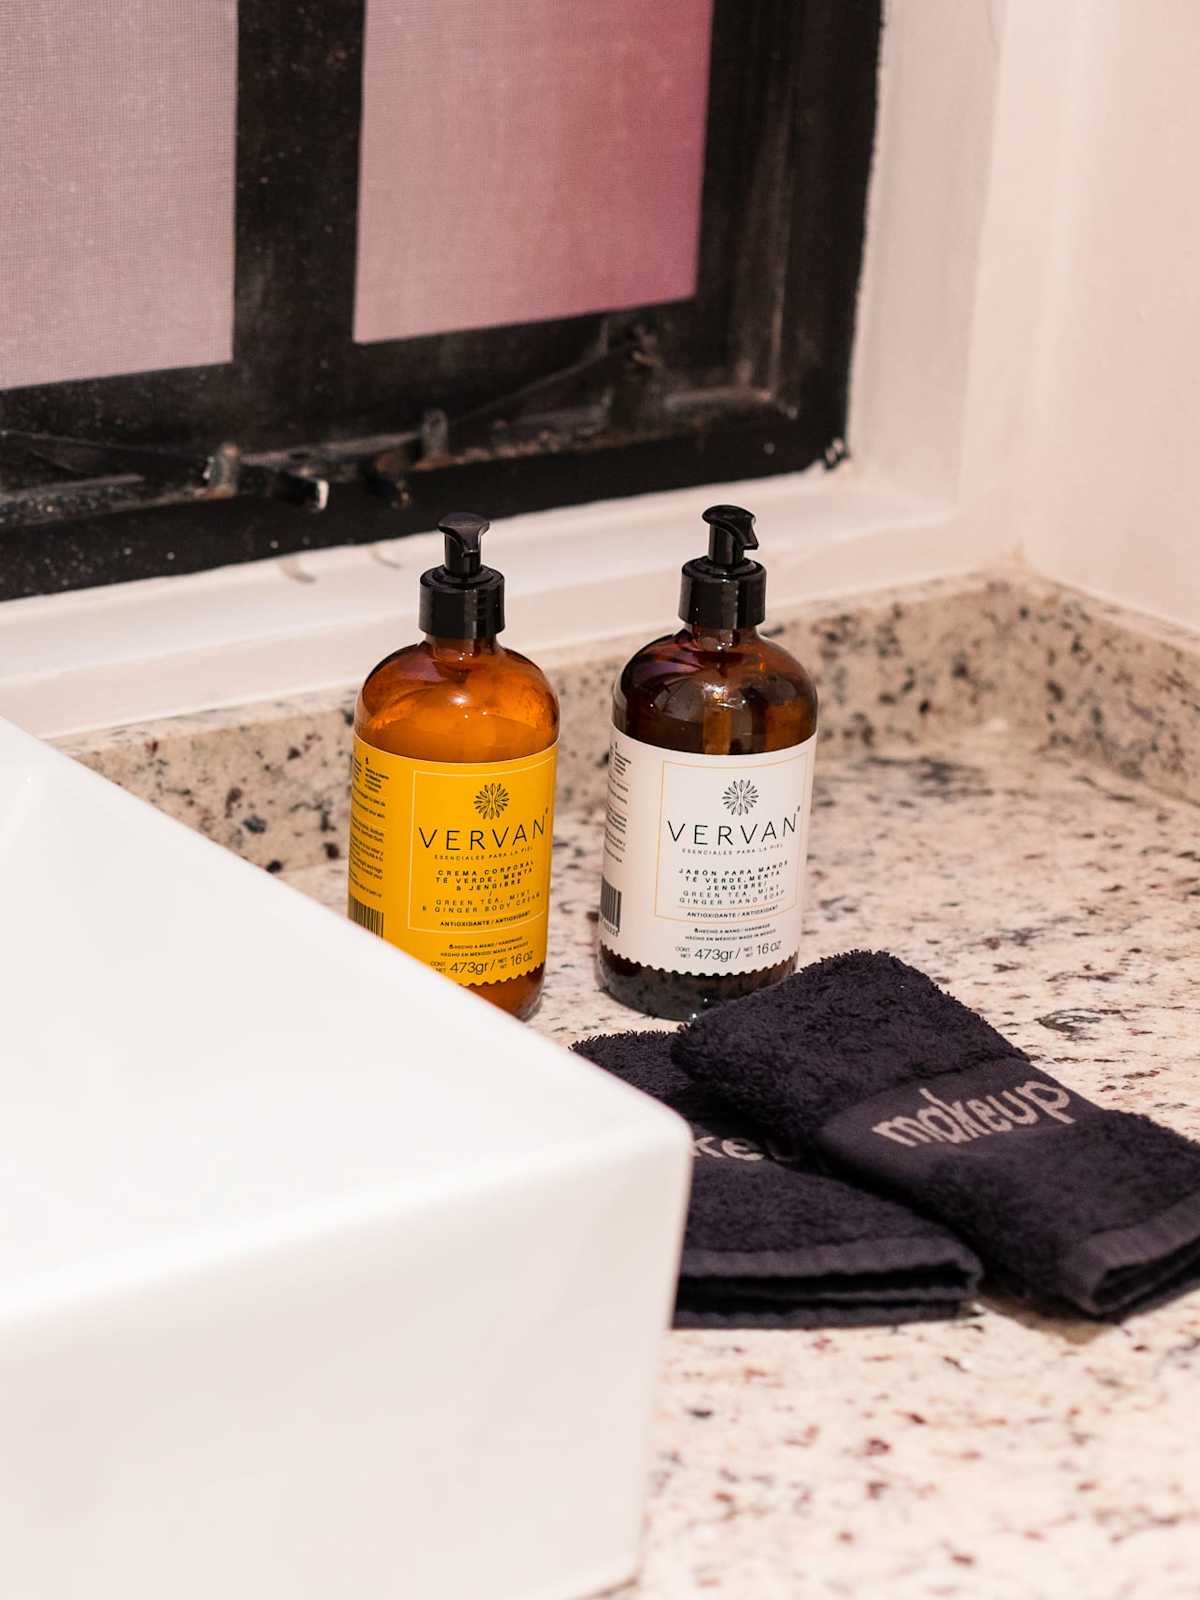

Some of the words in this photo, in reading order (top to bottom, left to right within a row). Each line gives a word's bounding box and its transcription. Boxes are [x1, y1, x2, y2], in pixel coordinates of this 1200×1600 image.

[418, 815, 545, 851] VERVAN
[667, 812, 797, 846] VERVAN
[438, 869, 478, 877] CREMA
[484, 860, 535, 875] CORPORAL
[503, 867, 533, 880] MENTA
[468, 878, 521, 892] JENGIBRE
[682, 889, 720, 899] GREEN
[434, 905, 479, 914] GINGER
[484, 901, 511, 913] BODY
[435, 899, 474, 907] GREEN
[679, 896, 723, 906] GINGER
[686, 911, 737, 919] ANTIOXIDANTE
[440, 919, 490, 928] ANTIOXIDANTE
[871, 1080, 1077, 1147] makeup
